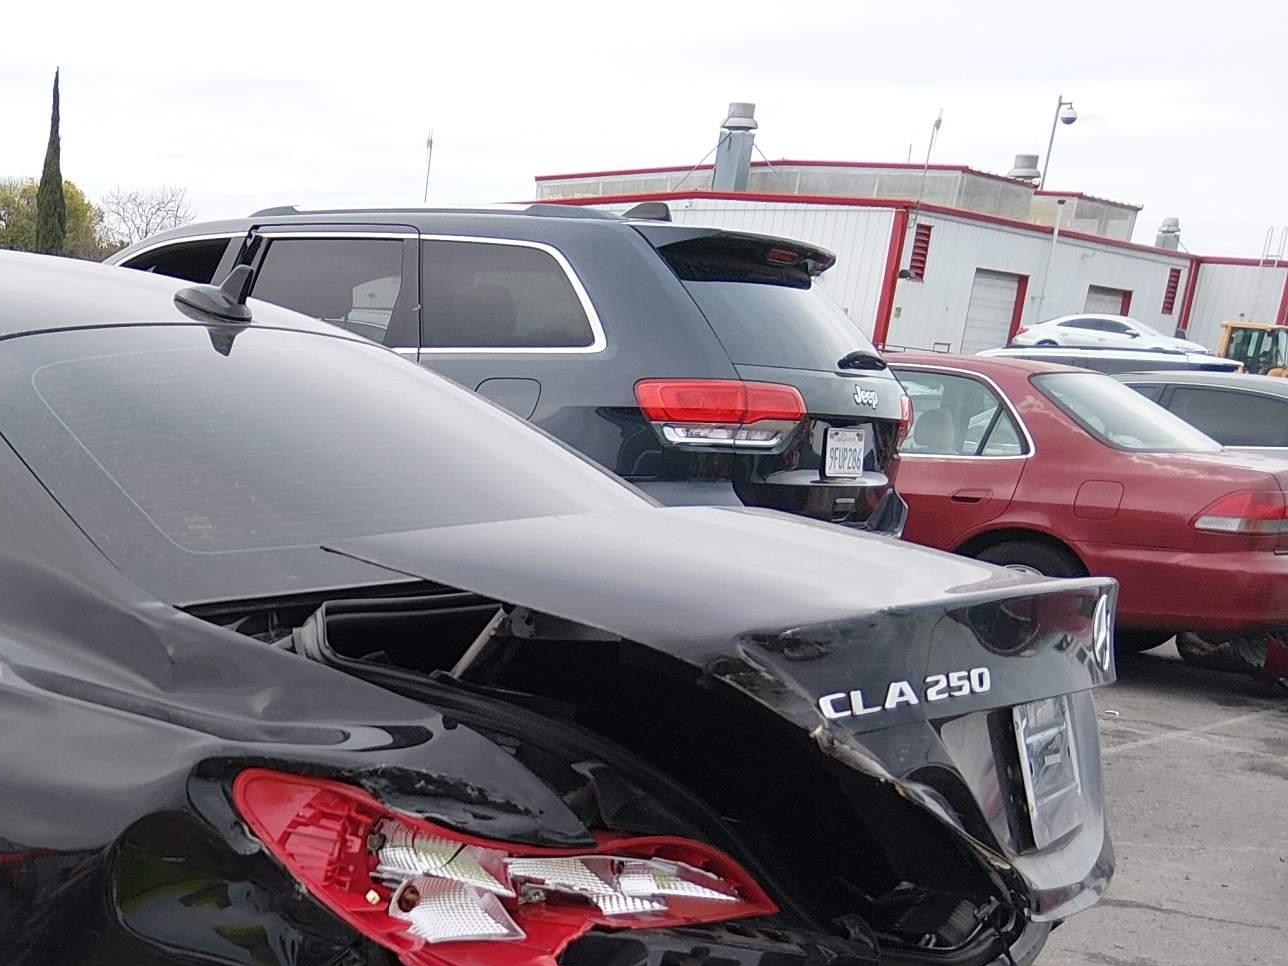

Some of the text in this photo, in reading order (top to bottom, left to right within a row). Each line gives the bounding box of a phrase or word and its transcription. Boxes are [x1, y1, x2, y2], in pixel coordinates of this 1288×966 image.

[853, 385, 879, 410] Jeep
[819, 667, 991, 719] CLA 250
